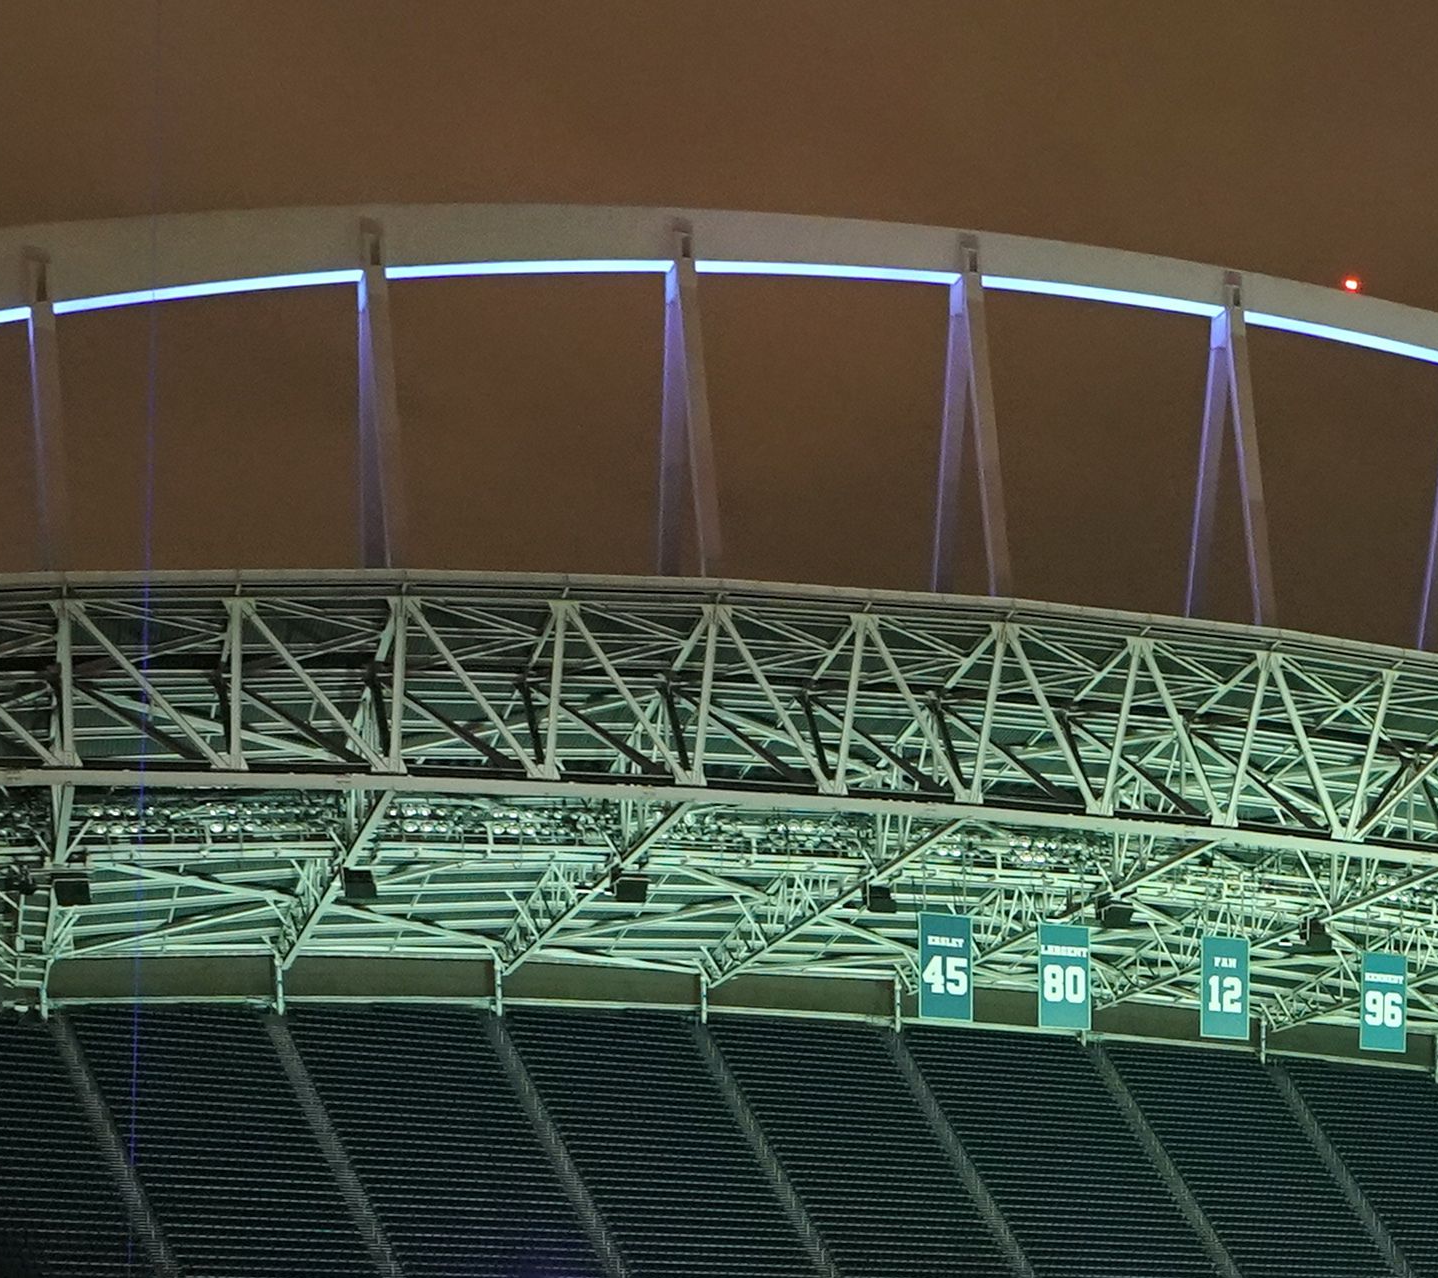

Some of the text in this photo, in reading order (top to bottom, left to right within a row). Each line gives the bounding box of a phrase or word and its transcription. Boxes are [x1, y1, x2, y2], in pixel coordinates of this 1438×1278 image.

[922, 955, 968, 995] 45
[1213, 957, 1237, 969] FAN
[1043, 964, 1086, 1003] 80
[1207, 974, 1243, 1014] 12
[1364, 990, 1404, 1028] 96
